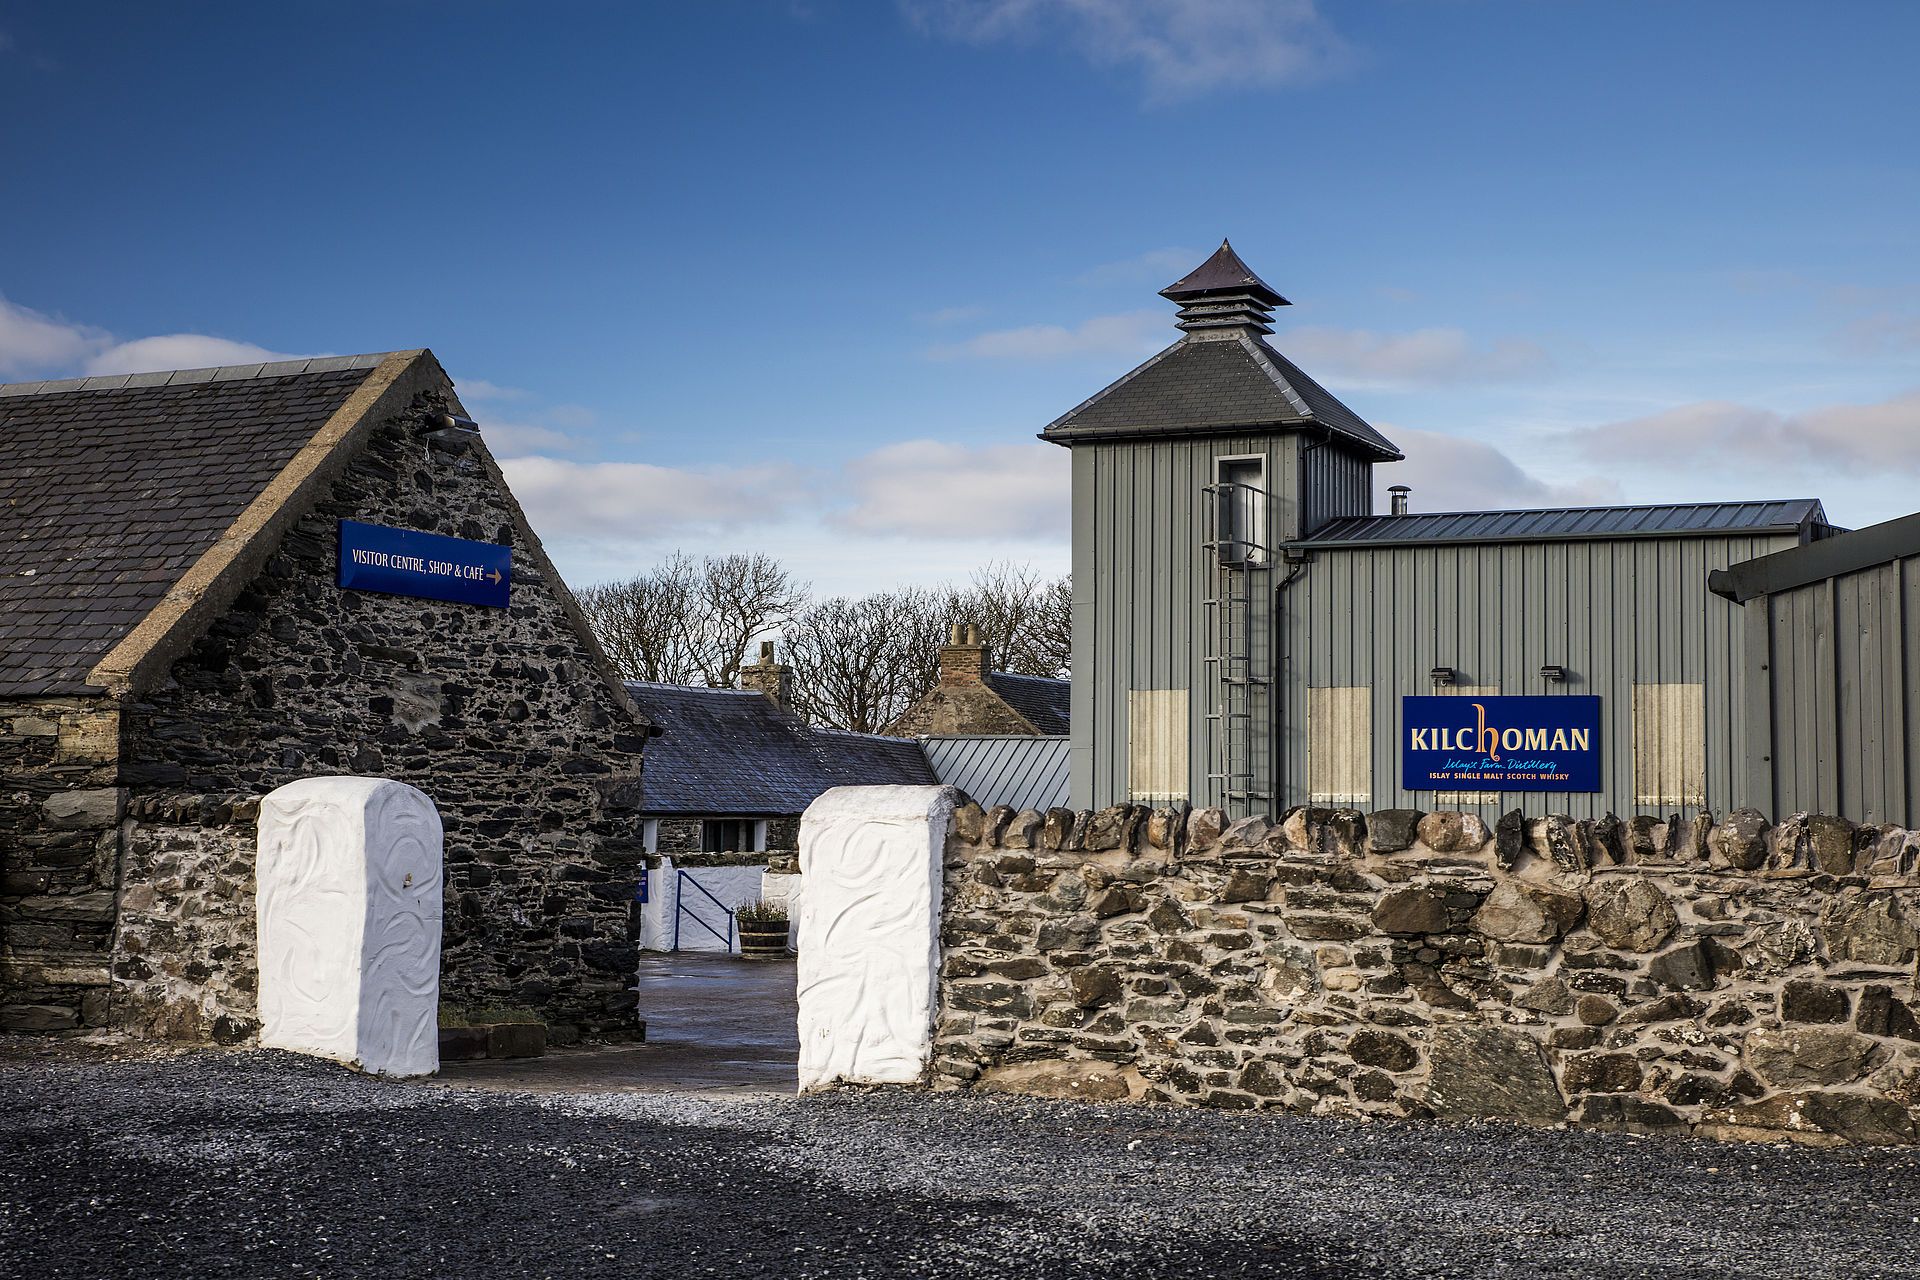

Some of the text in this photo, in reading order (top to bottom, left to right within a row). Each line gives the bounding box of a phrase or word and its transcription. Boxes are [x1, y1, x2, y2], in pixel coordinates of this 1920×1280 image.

[352, 548, 484, 581] VISITOR CENTRE, SHOP & CAFÉ
[1480, 759, 1506, 770] Farm
[1507, 758, 1557, 775] Distillery
[1453, 772, 1481, 780] SINGLE
[1483, 772, 1504, 780] MALT
[1539, 773, 1570, 781] WHISKY
